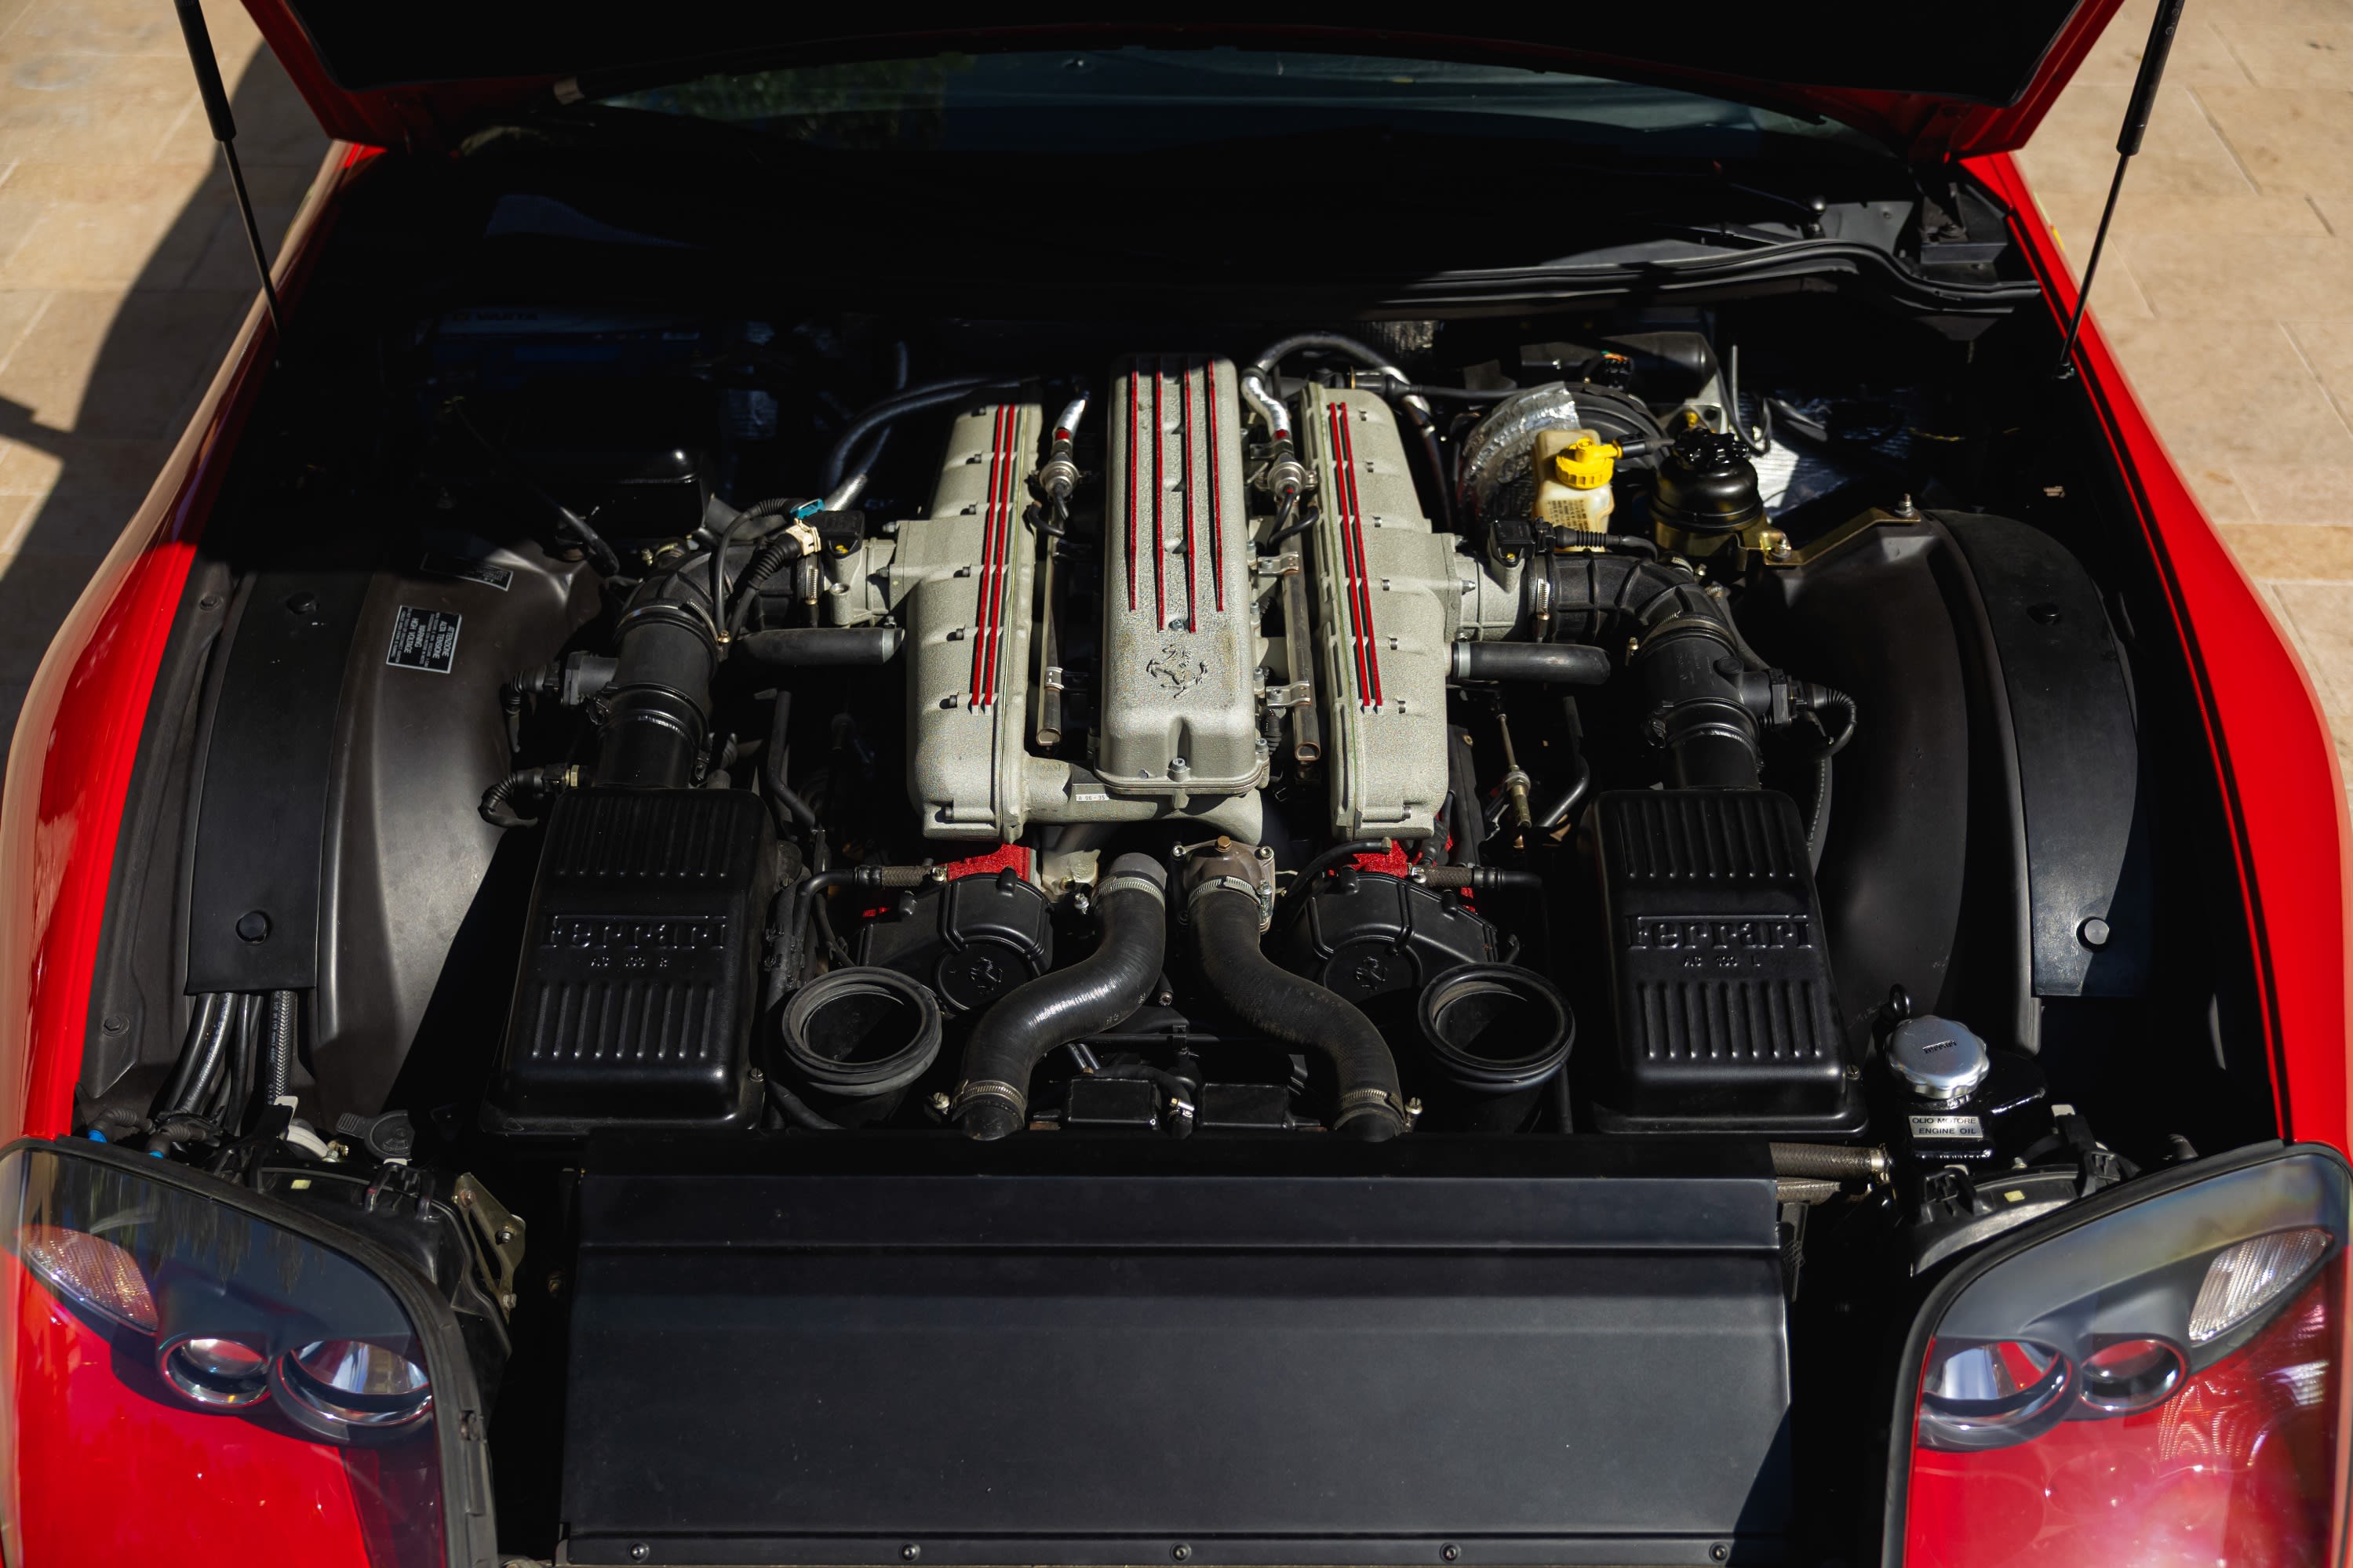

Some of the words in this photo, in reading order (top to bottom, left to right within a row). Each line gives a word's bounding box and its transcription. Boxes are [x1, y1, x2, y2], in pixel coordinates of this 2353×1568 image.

[410, 617, 419, 630] HIGH
[439, 620, 448, 632] ALTA
[404, 631, 416, 653] VOLTAGE
[414, 624, 427, 648] WARNING
[432, 633, 445, 660] TENSIONE
[442, 625, 455, 658] ATTENZIONE
[538, 915, 727, 949] Ferrari
[1626, 914, 1813, 949] Ferrari
[1750, 955, 1761, 967] L
[1922, 1039, 1958, 1054] Ferrari
